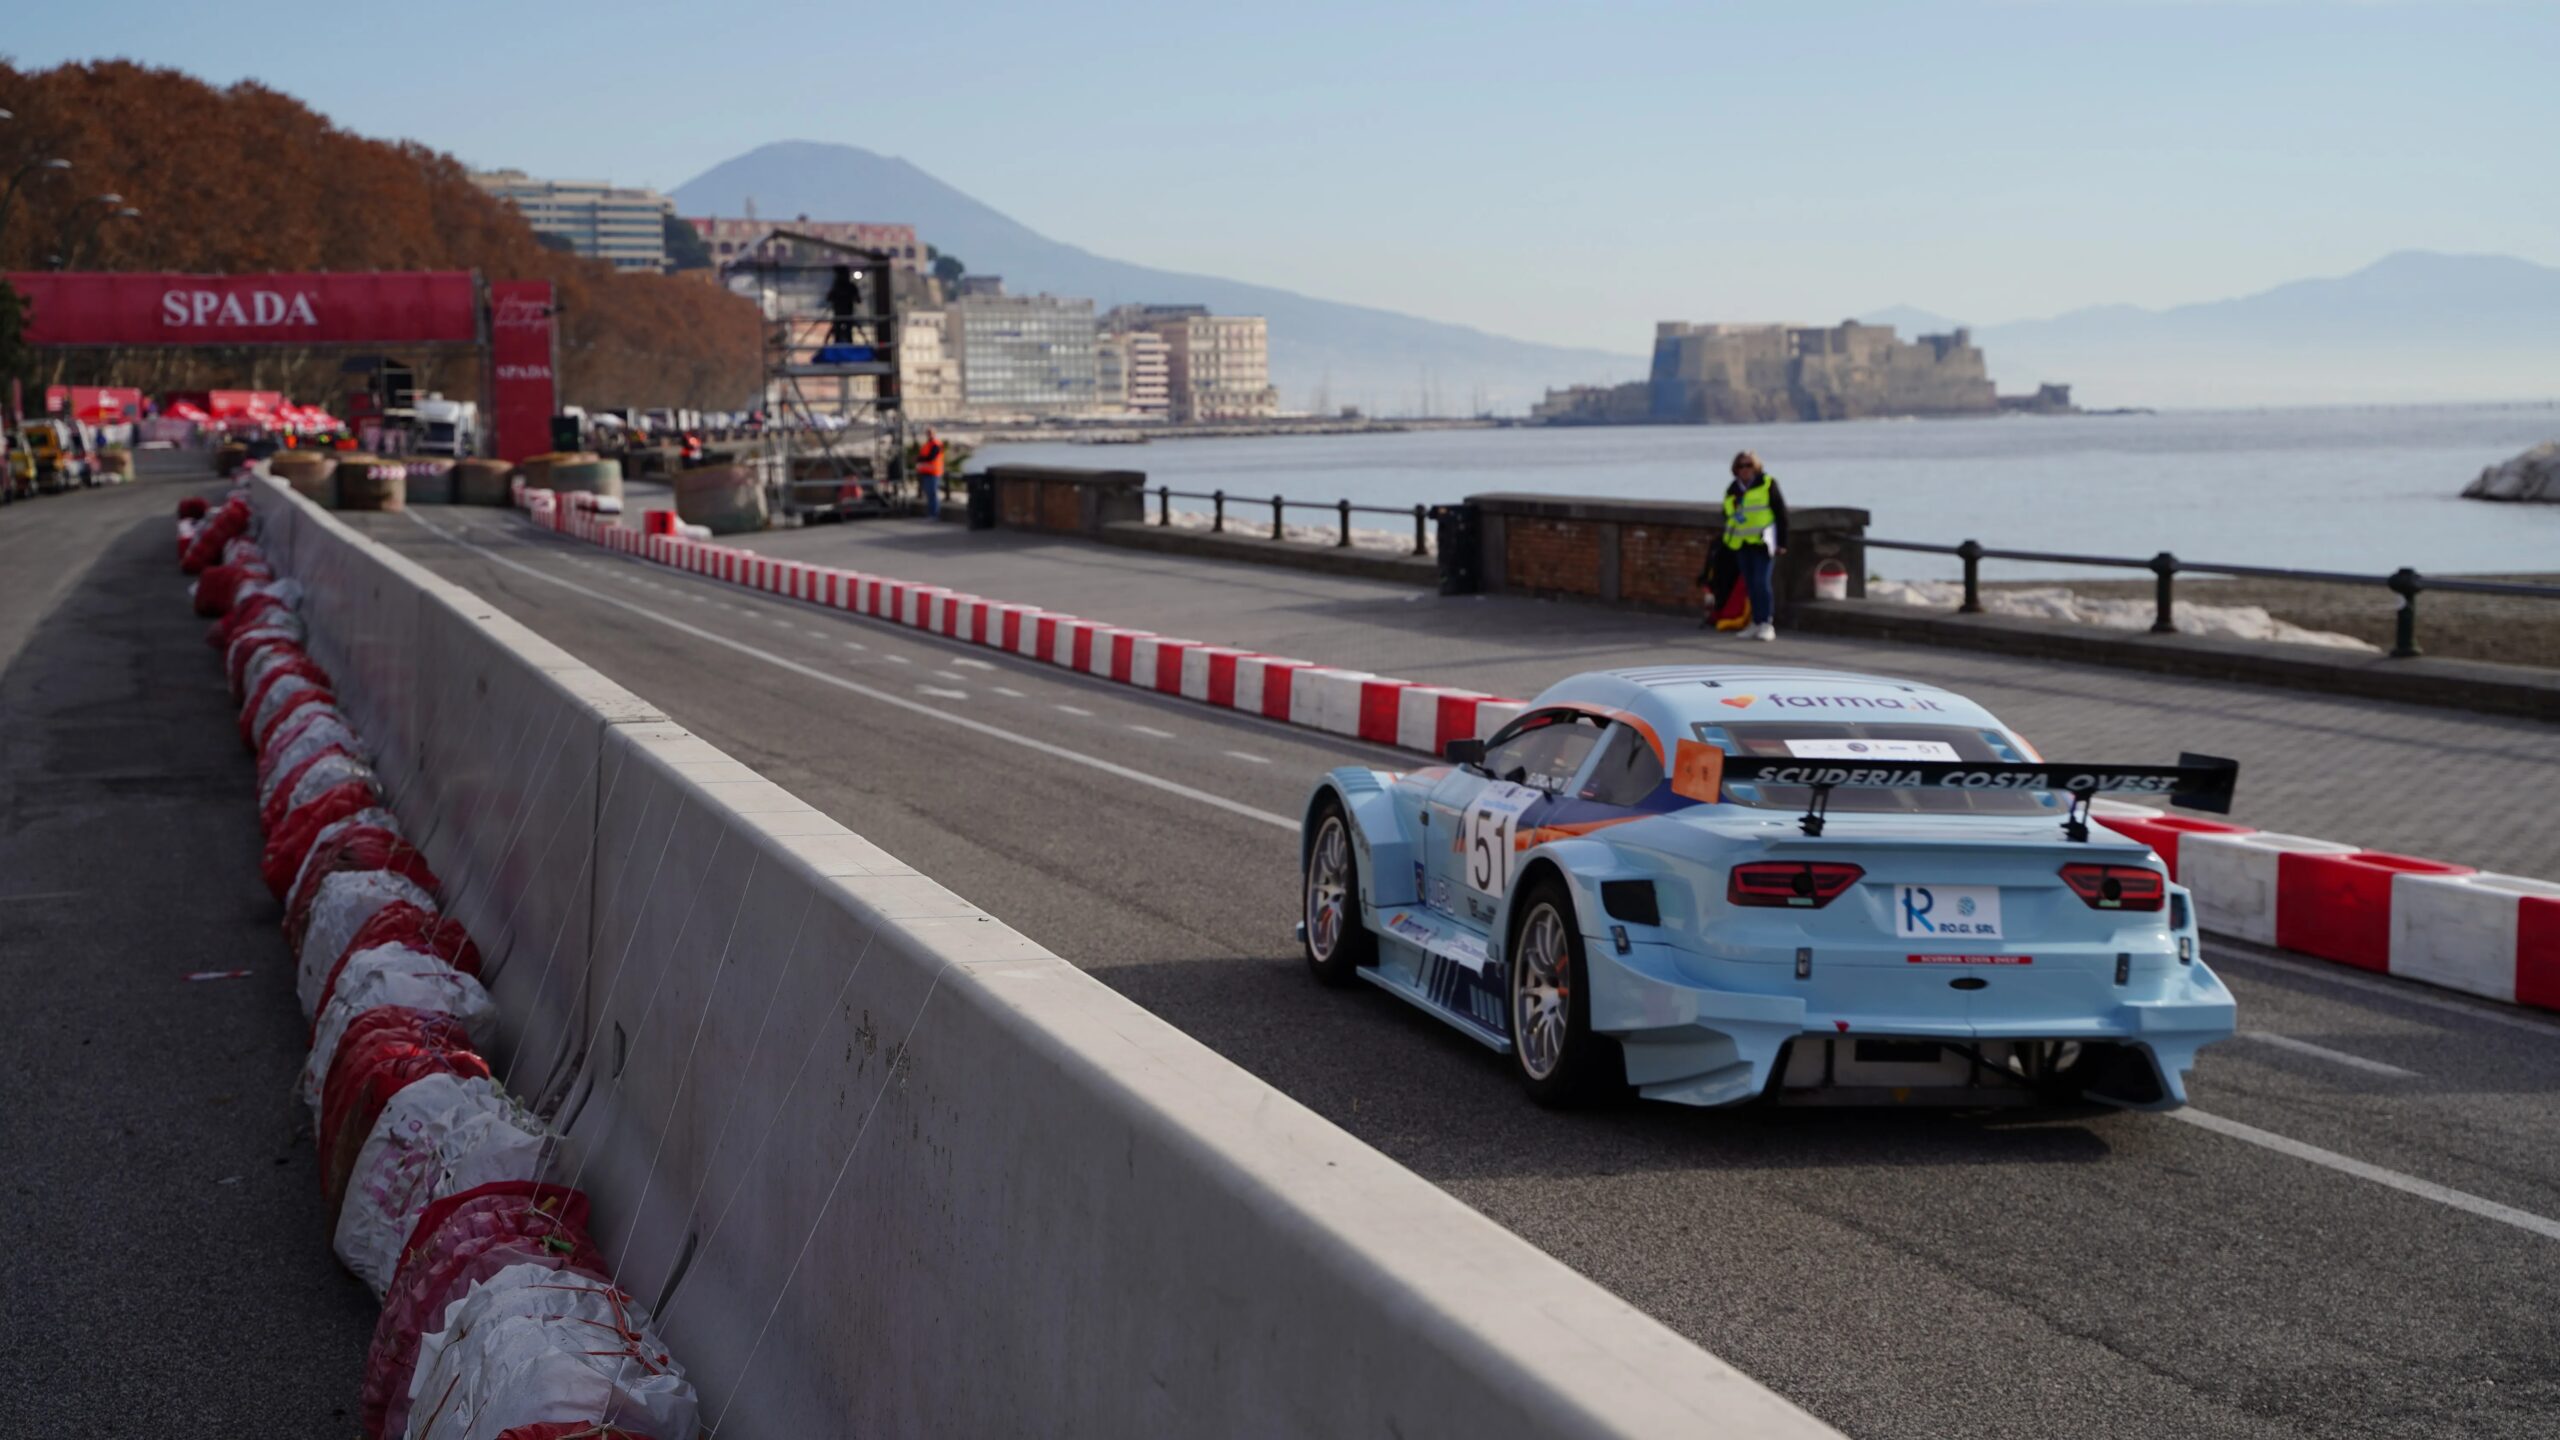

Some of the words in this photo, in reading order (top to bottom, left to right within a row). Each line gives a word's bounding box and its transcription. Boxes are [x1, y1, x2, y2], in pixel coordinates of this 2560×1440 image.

[162, 289, 318, 327] SPADA
[497, 364, 553, 378] SPADA
[1768, 693, 1946, 713] farma.it
[1753, 766, 1923, 787] SCUDERIA
[1940, 770, 2049, 790] COSTA
[2065, 773, 2180, 792] OVEST
[1474, 809, 1509, 893] 51
[1975, 924, 1997, 935] SRL
[1921, 955, 1962, 963] SCUDERIA
[1994, 956, 2020, 964] OVEST
